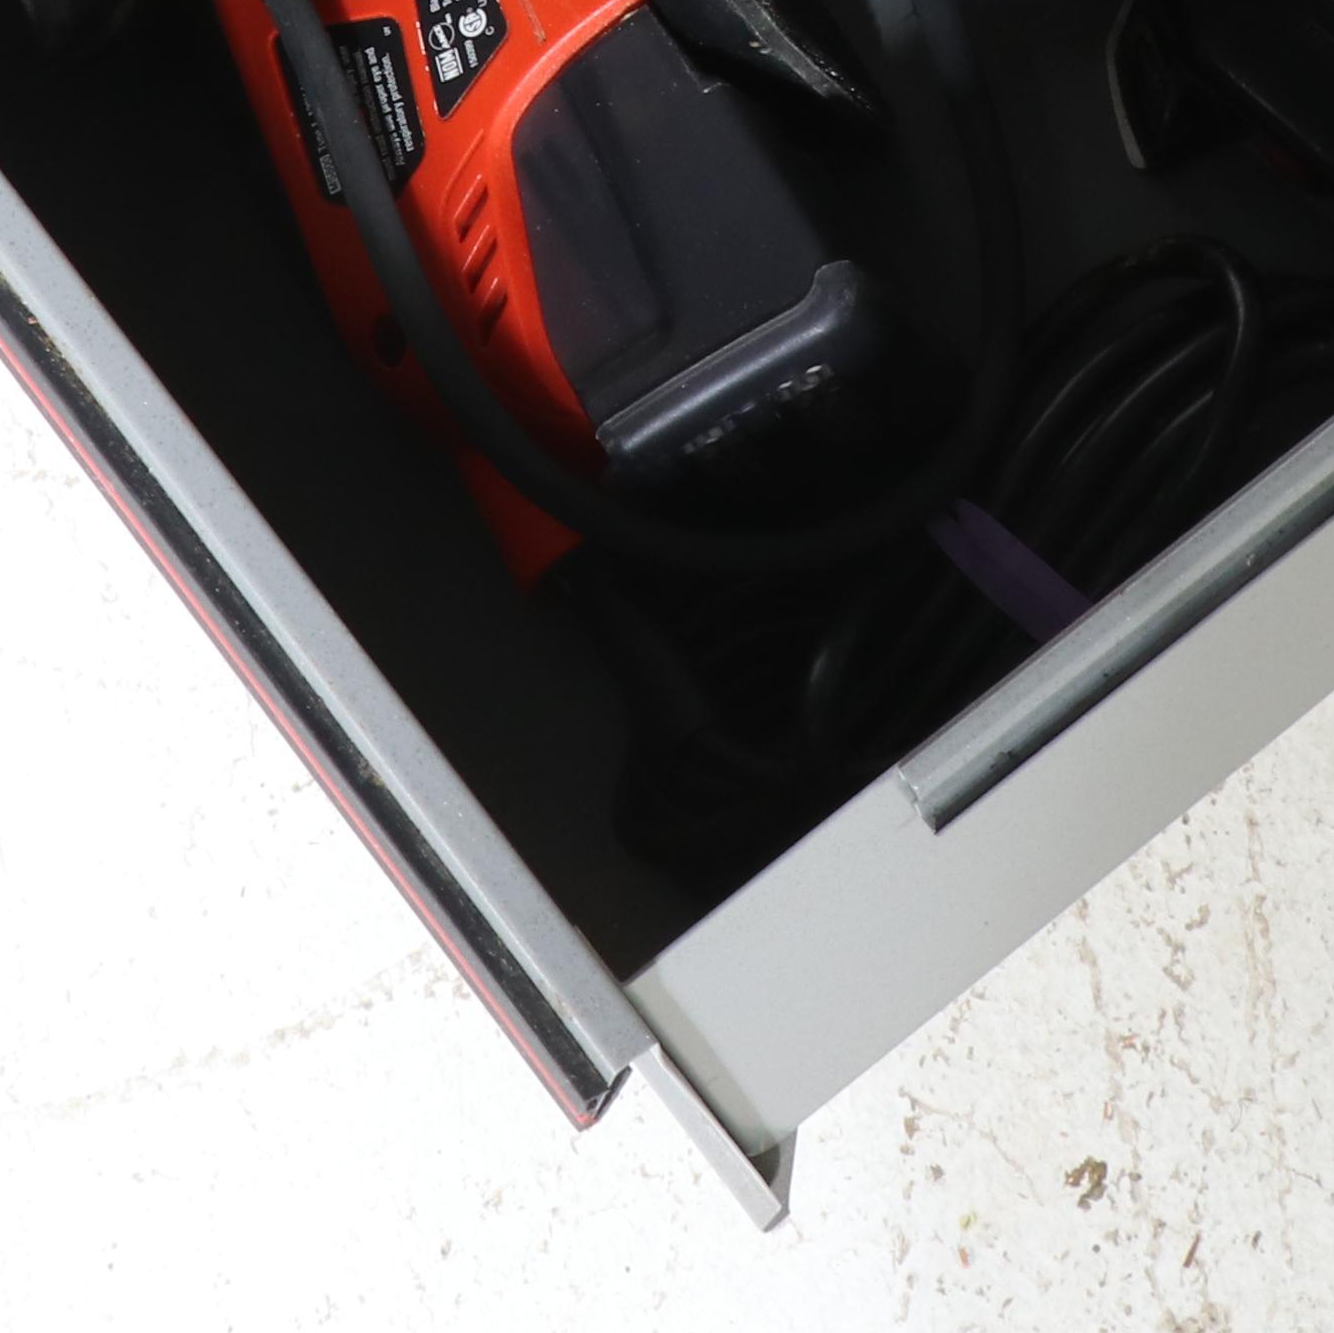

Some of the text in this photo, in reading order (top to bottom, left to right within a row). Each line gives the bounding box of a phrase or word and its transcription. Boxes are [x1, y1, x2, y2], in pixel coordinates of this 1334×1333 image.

[363, 46, 377, 65] and
[438, 48, 459, 80] NOM
[392, 101, 414, 152] respiratory
